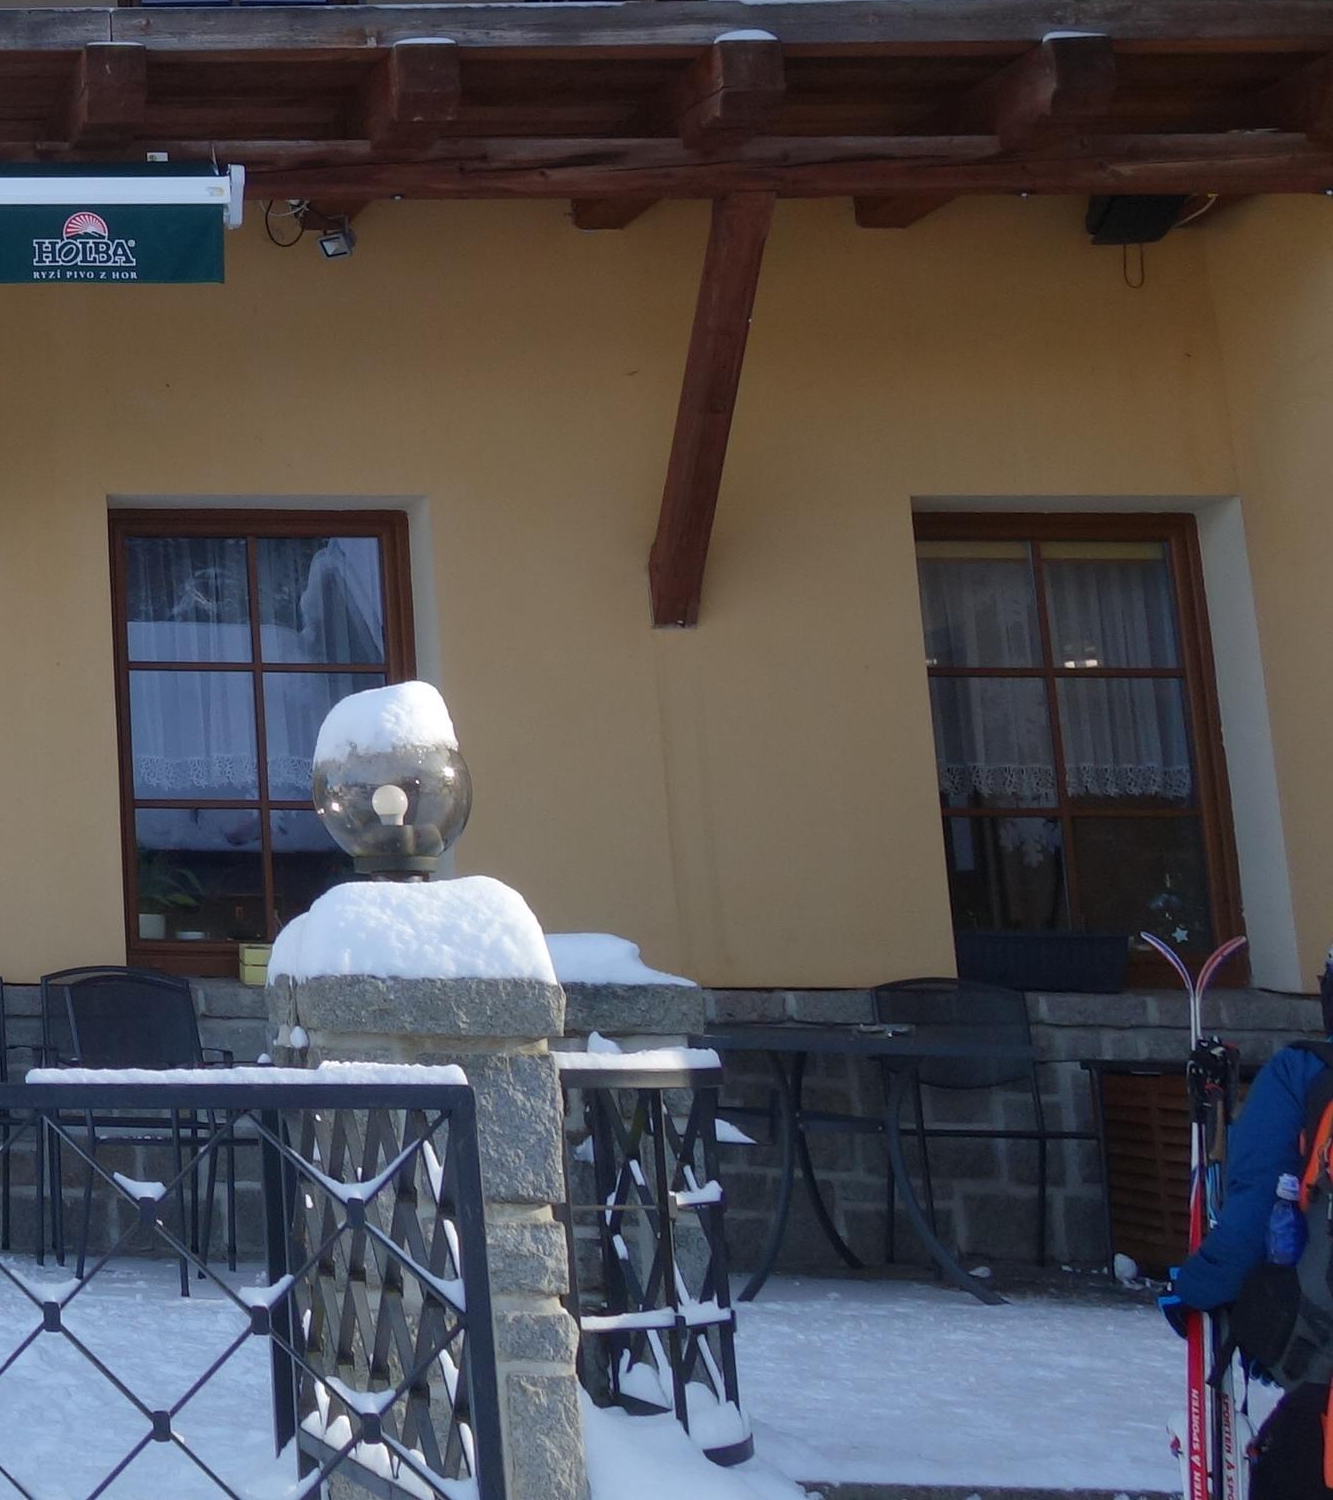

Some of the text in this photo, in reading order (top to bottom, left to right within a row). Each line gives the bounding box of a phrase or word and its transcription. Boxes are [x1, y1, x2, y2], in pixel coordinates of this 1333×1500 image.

[33, 239, 136, 266] HOLBA
[33, 269, 138, 280] RYZÍ PIVO Z HOR
[1190, 1388, 1201, 1452] SPORTEN
